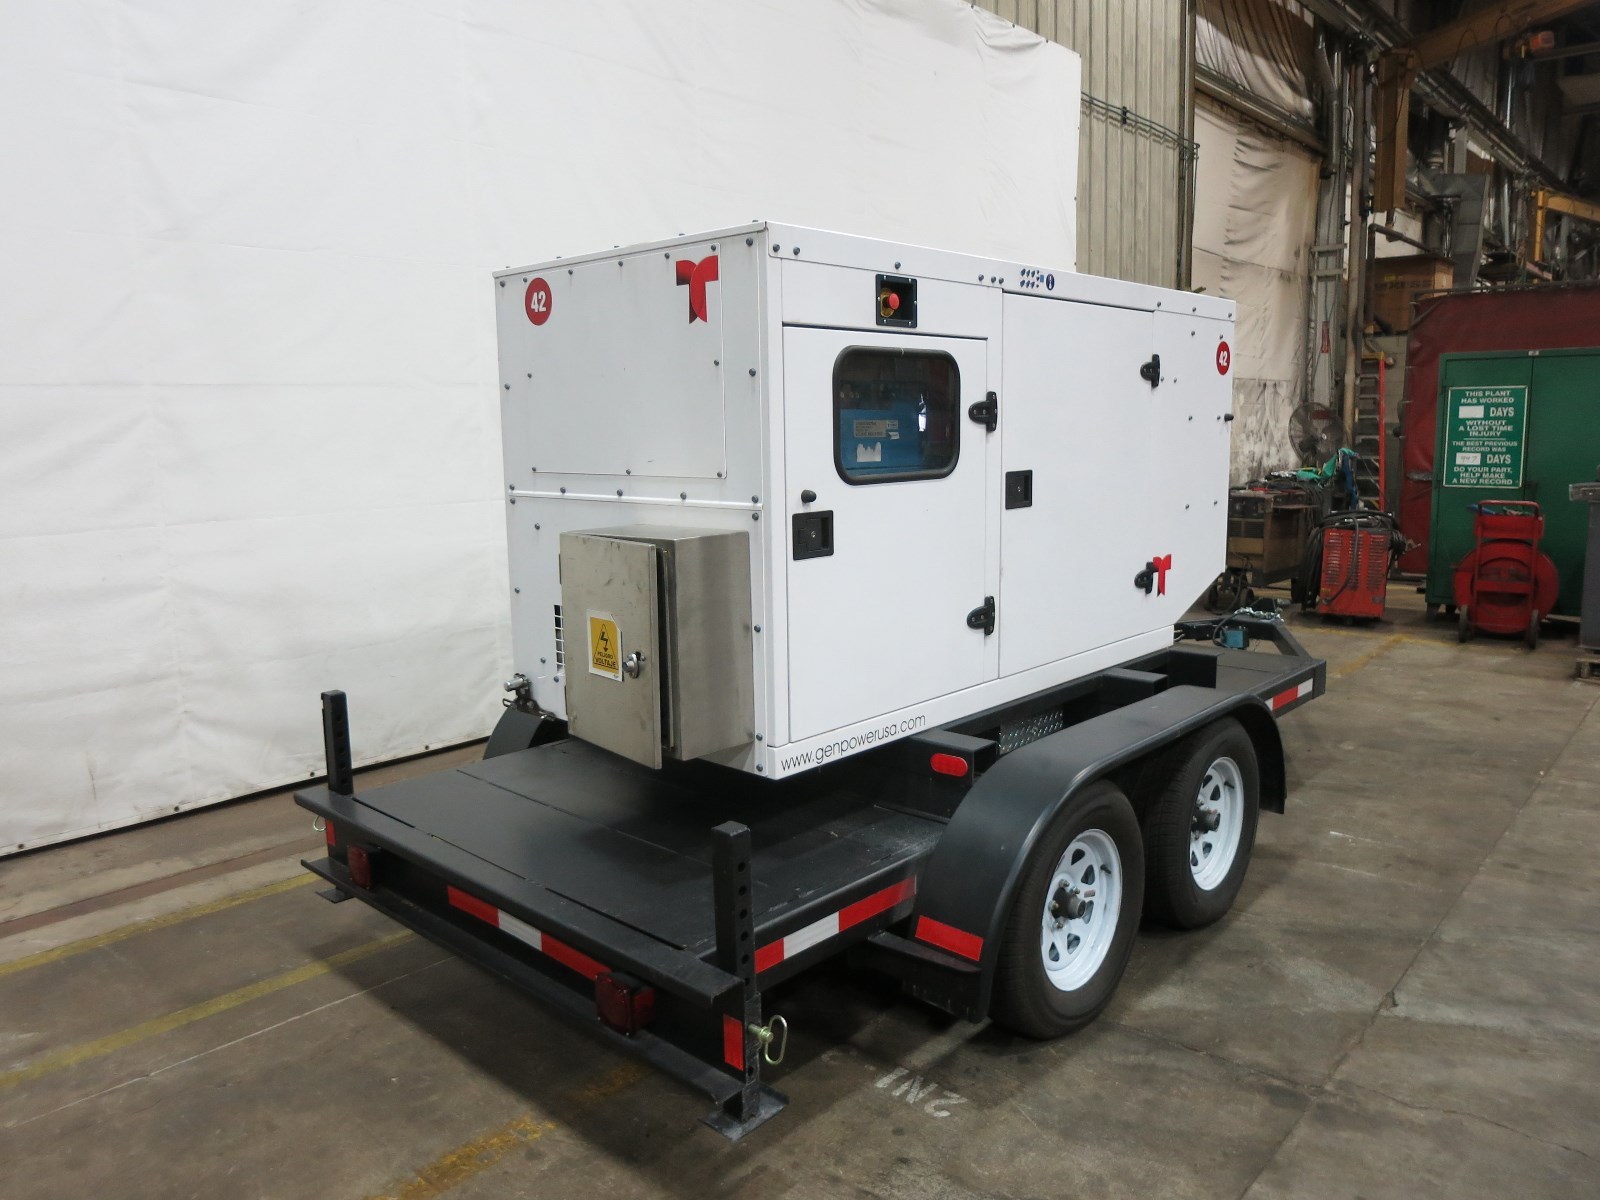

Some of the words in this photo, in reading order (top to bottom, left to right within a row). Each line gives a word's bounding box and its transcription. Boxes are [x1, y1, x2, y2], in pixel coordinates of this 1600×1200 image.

[531, 291, 546, 313] 42
[1219, 350, 1228, 366] 42
[1489, 407, 1515, 417] DAYS
[1486, 454, 1512, 464] DAYS
[595, 657, 616, 668] VOLTAJE
[781, 714, 926, 771] www.genpowerusa.com
